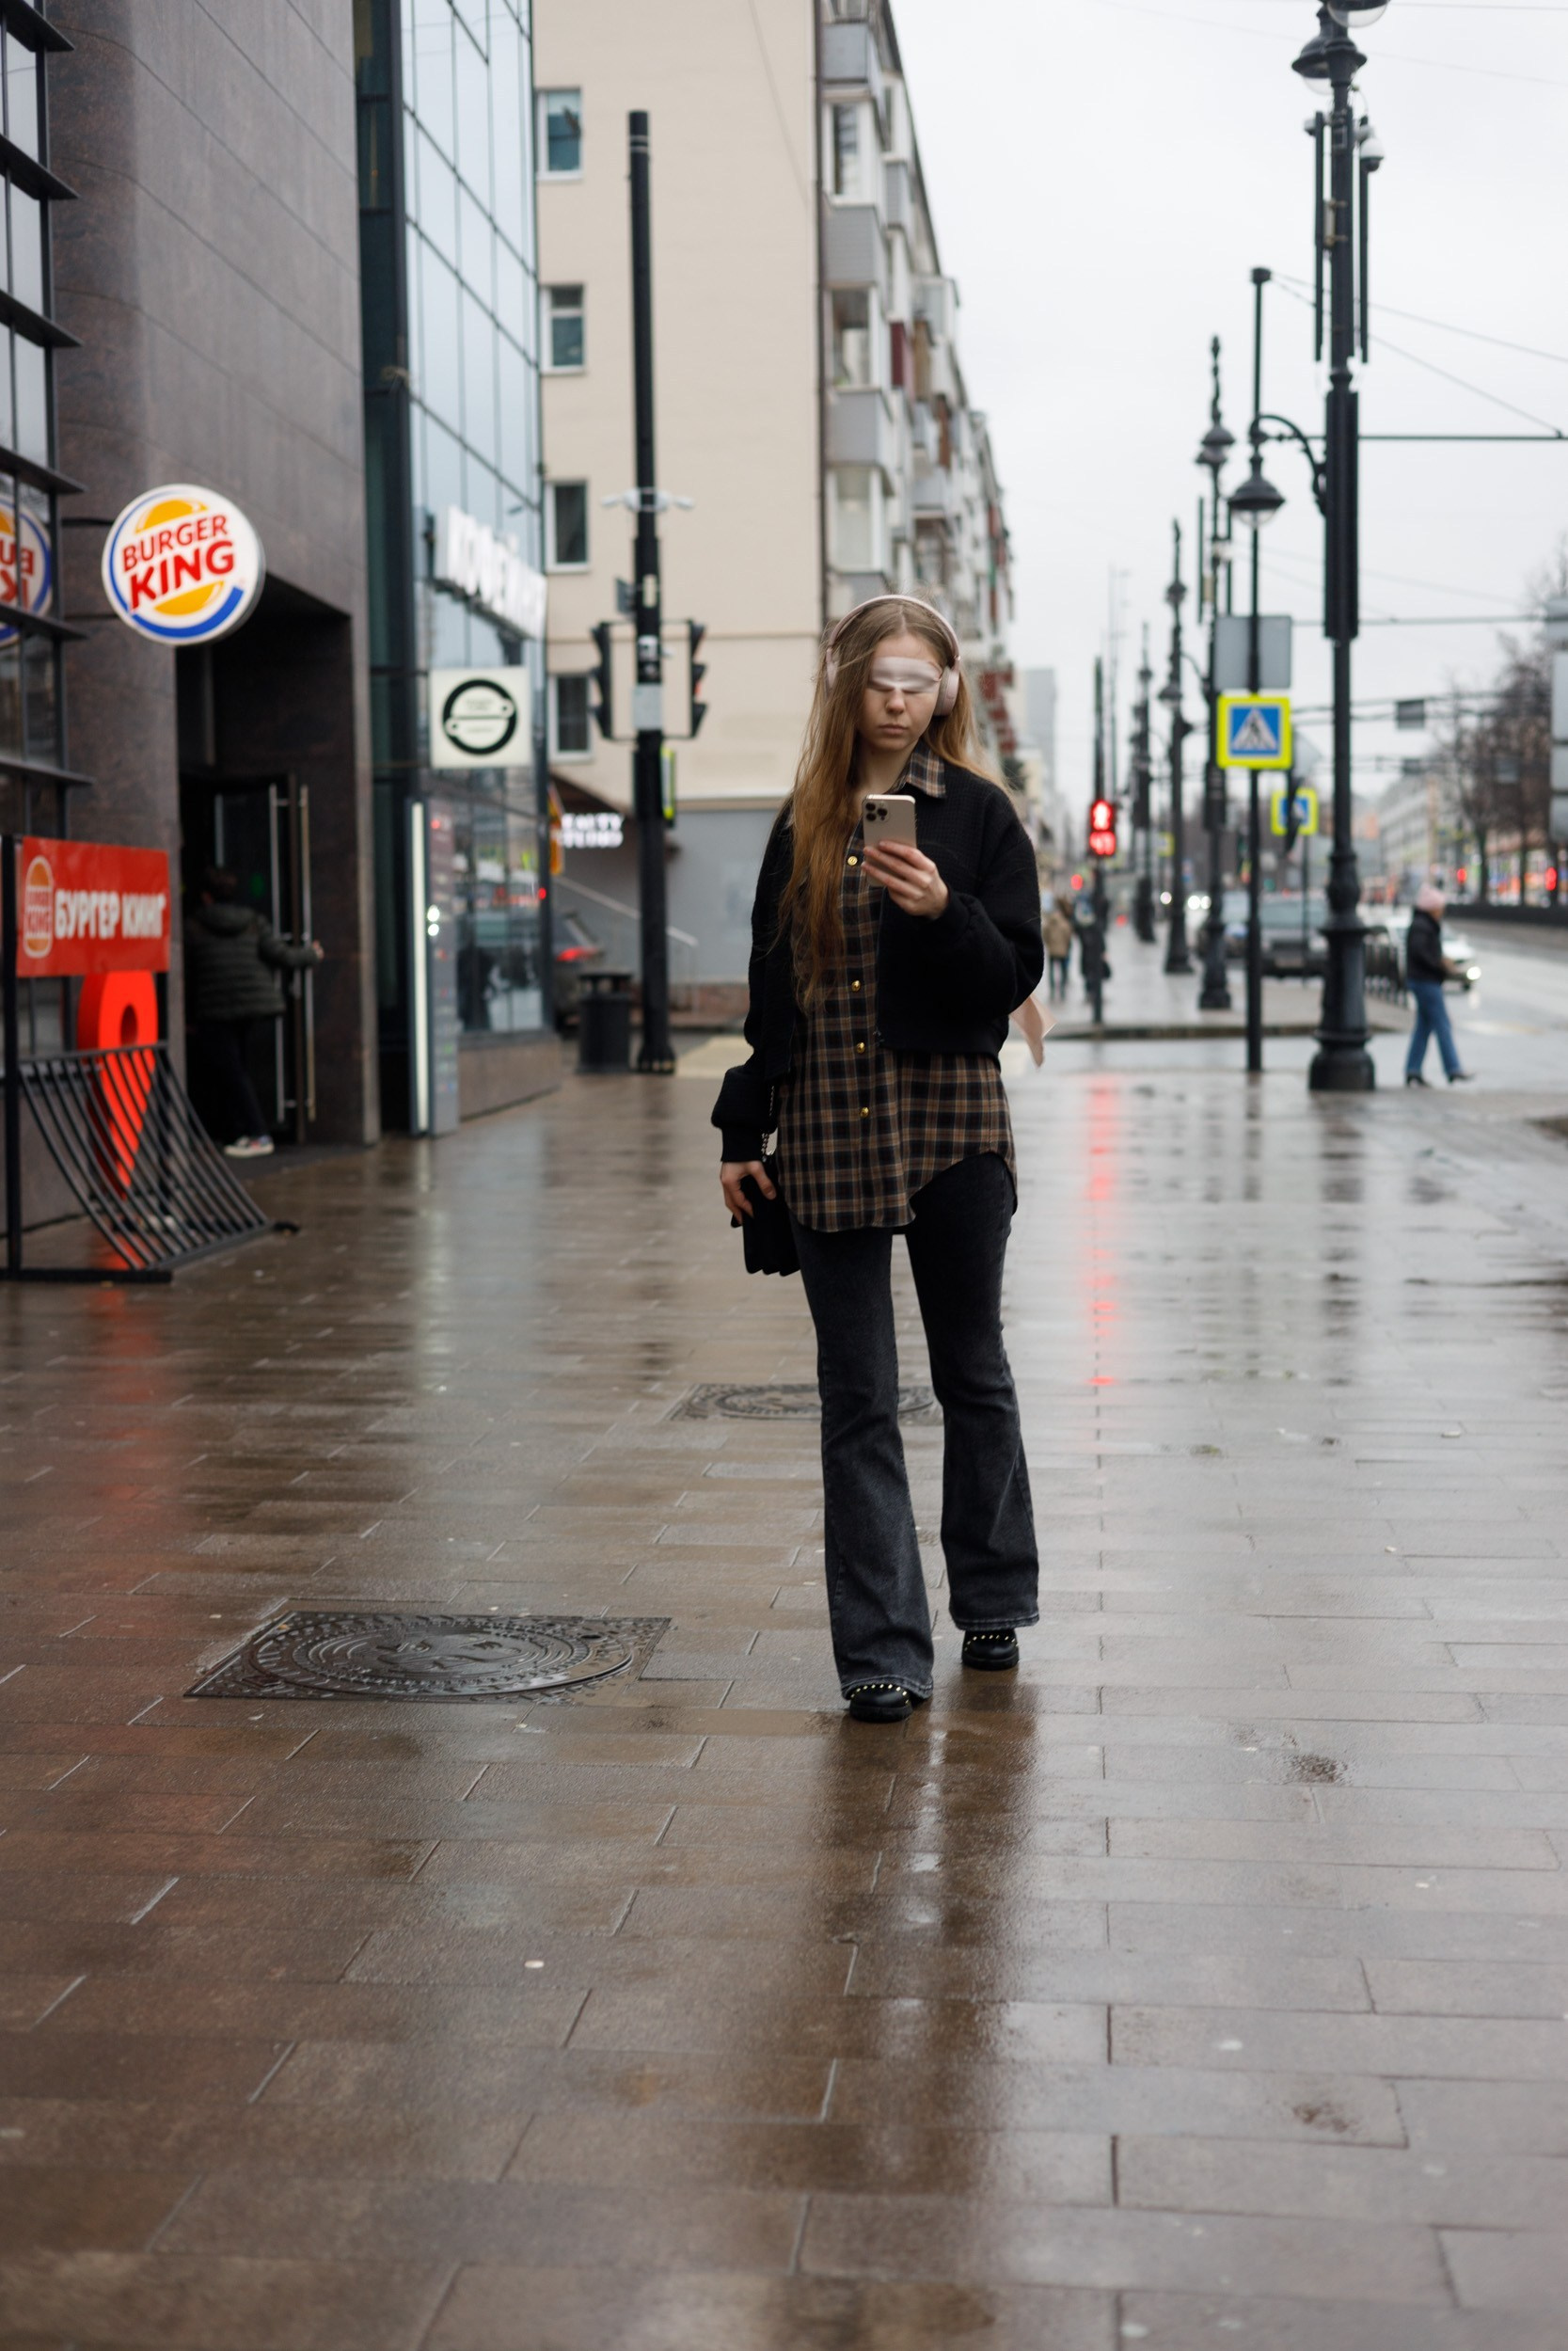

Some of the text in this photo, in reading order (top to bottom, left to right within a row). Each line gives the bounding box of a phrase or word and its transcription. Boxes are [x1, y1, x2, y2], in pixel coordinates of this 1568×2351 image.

[123, 515, 228, 572] BURGER
[131, 540, 234, 609] KING
[55, 889, 119, 939] БУРГЕР
